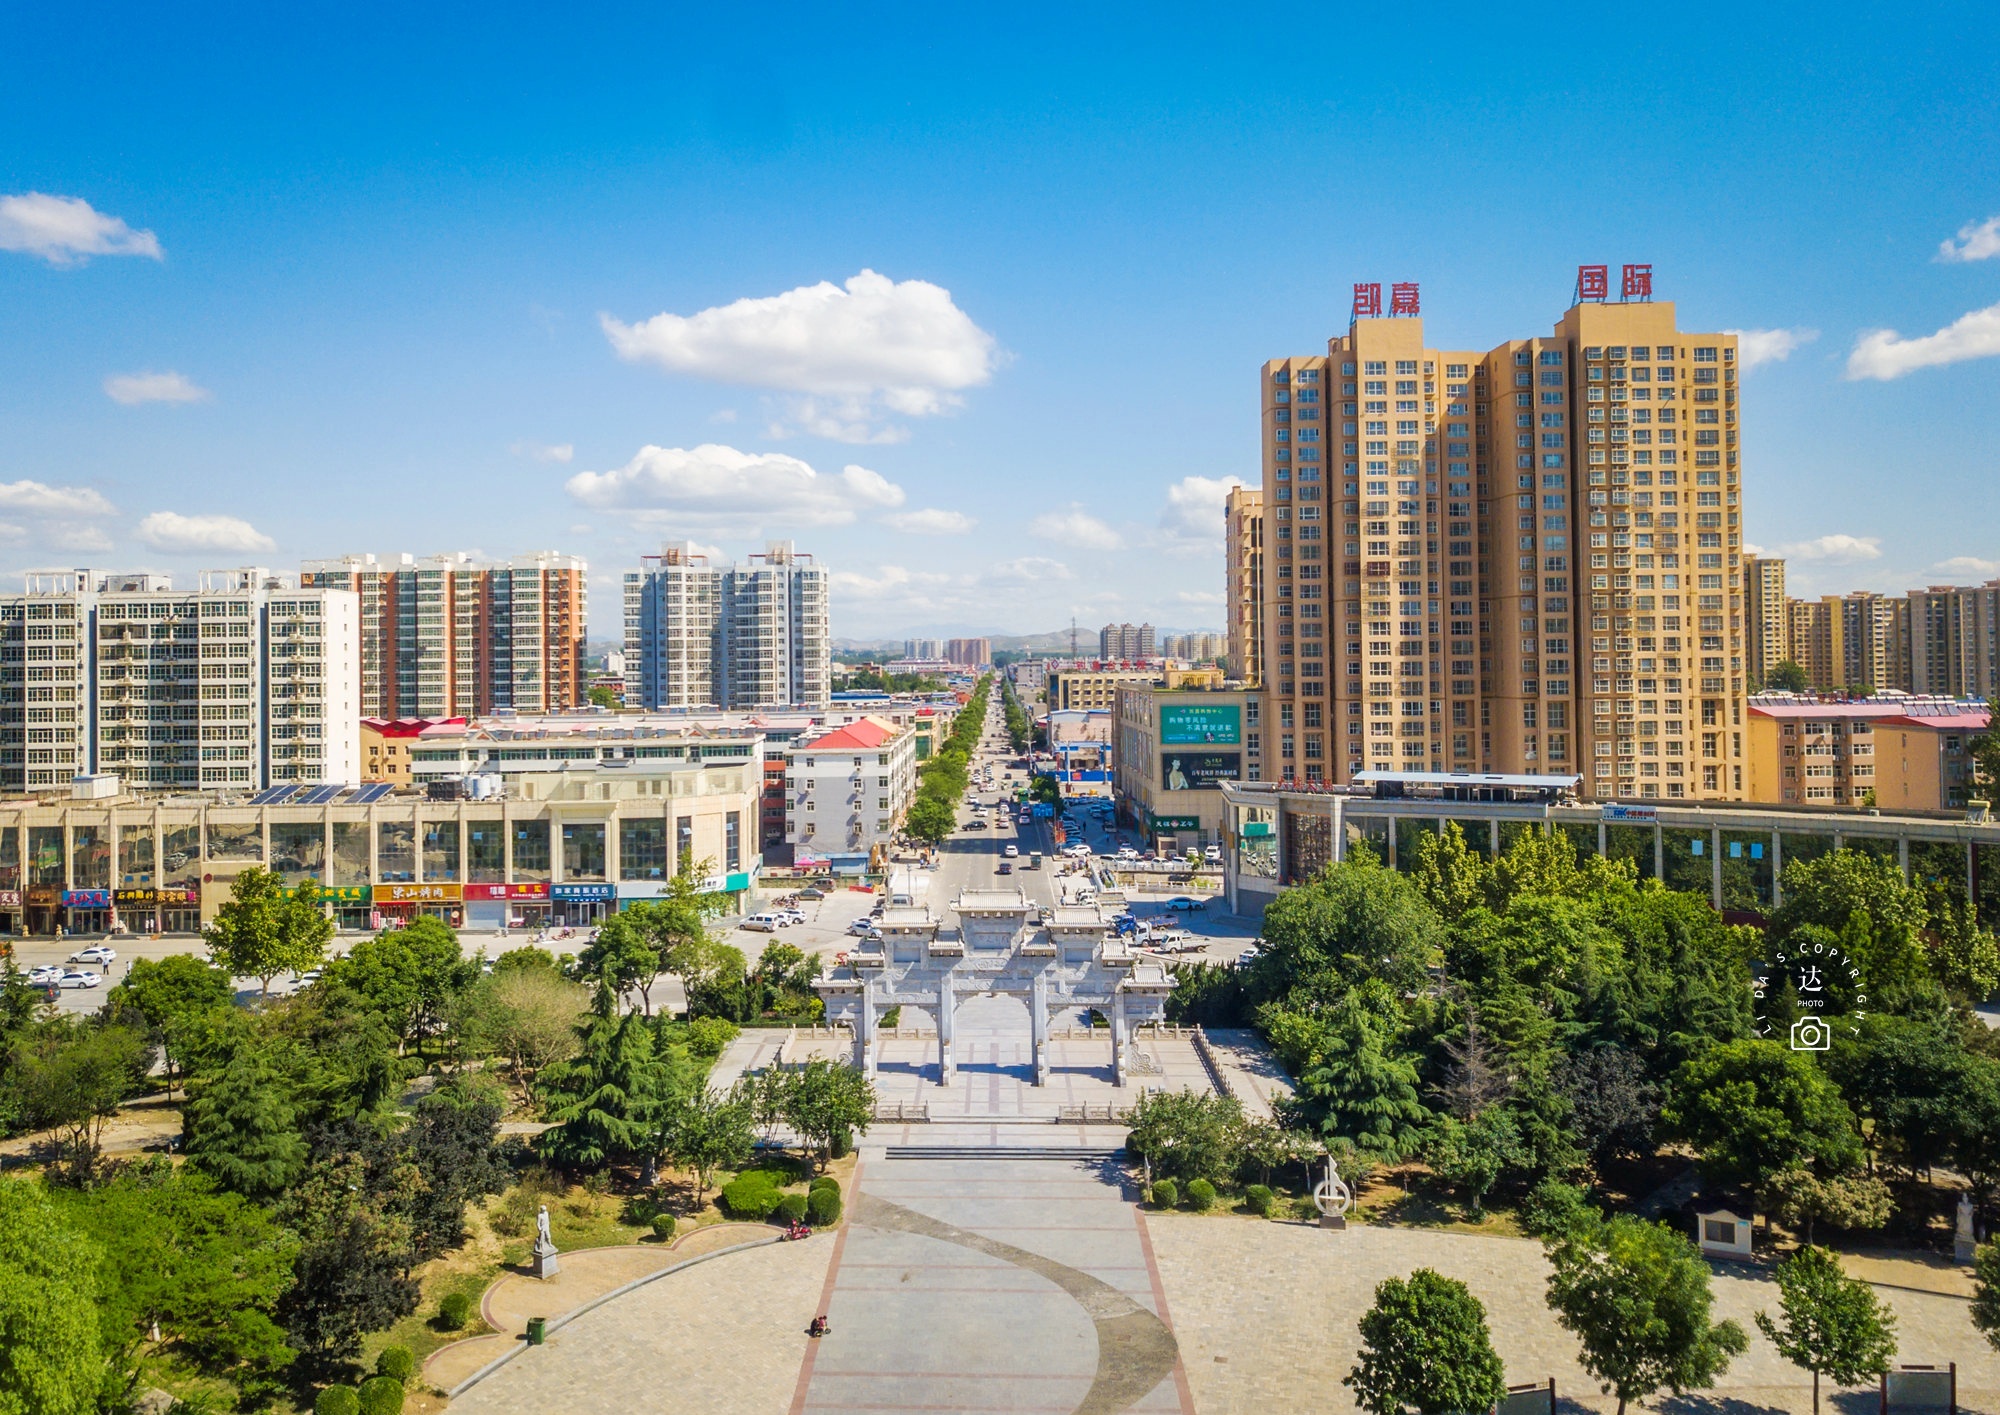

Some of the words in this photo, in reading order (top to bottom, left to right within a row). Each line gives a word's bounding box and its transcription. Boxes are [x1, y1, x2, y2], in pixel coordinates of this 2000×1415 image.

[1578, 264, 1652, 299] 国际
[1353, 282, 1420, 315] 凯嘉
[393, 886, 443, 899] 梁山烤肉
